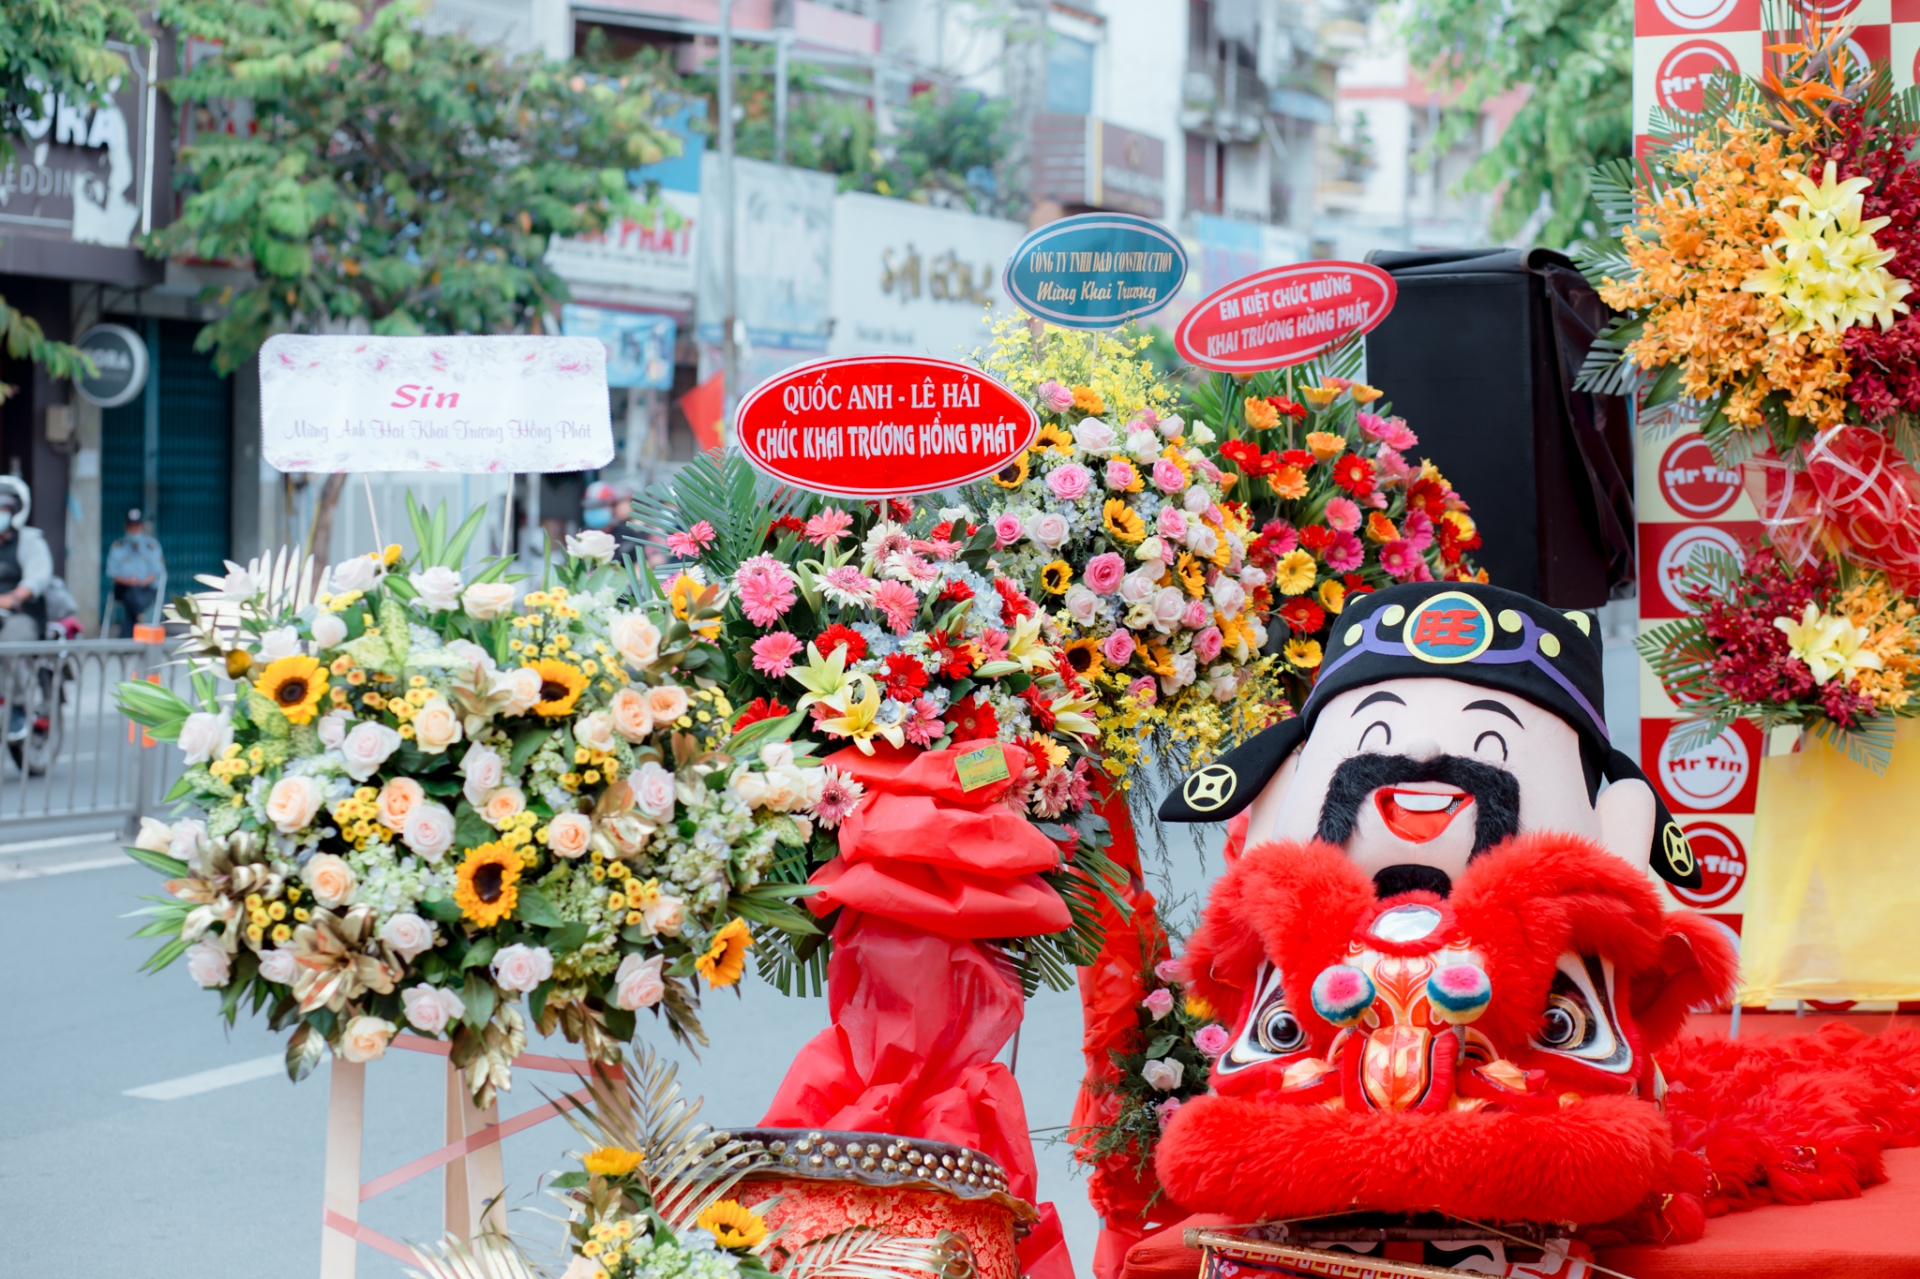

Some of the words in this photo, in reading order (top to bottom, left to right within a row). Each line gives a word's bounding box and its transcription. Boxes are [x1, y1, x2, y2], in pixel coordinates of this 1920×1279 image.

[1661, 76, 1697, 95] Mr
[1030, 245, 1054, 273] CÔNG
[1056, 251, 1068, 273] TY
[1037, 281, 1077, 305] Mừng
[1080, 281, 1112, 301] Khai
[1219, 299, 1240, 321] EM
[1241, 288, 1270, 318] KIỆT
[1272, 280, 1308, 309] CHÚC
[1310, 274, 1352, 301] MỪNG
[1207, 330, 1239, 358] KHAI
[1241, 317, 1294, 350] TRƯƠNG
[1296, 307, 1335, 337] HỒNG
[1337, 297, 1371, 328] PHÁT
[391, 384, 460, 409] Sin
[783, 372, 842, 415] QUỐC
[847, 384, 893, 410] ANH
[911, 376, 936, 409] LÊ
[942, 374, 980, 408] HẢI
[555, 420, 592, 440] Phát
[756, 420, 799, 463] CHÚC
[803, 426, 844, 462] KHAI
[847, 420, 915, 460] TRƯƠNG
[919, 411, 967, 458] HỒNG
[970, 415, 1017, 457] PHÁT
[1664, 468, 1700, 486] Mr
[1413, 608, 1479, 646] 旺
[1668, 758, 1701, 774] Mr
[1705, 755, 1742, 774] Tin
[1703, 854, 1745, 878] Tin
